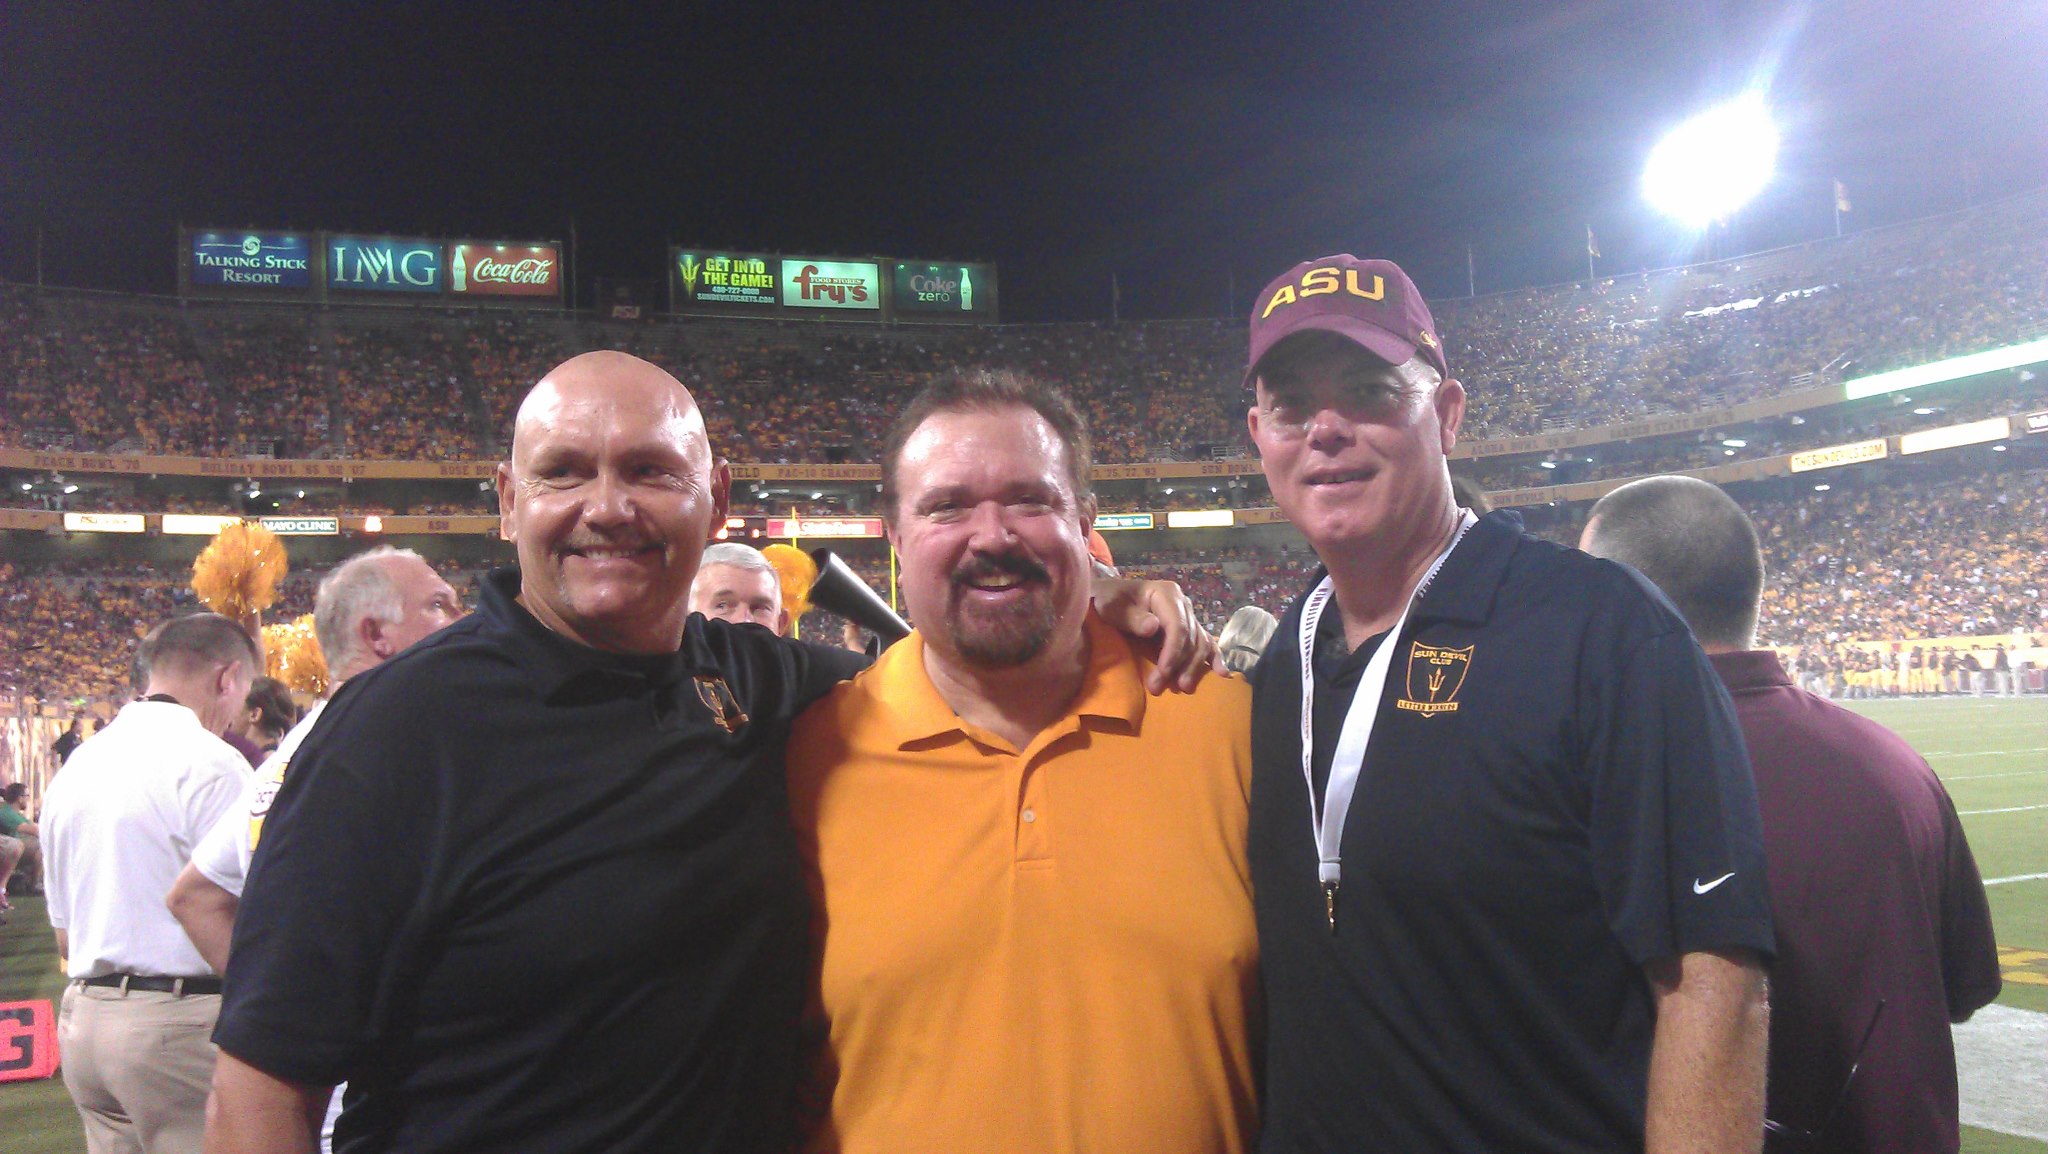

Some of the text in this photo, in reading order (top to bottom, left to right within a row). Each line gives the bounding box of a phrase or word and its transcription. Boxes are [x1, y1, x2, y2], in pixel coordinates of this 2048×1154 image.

[195, 252, 308, 270] TALKING STICK
[333, 246, 436, 286] IMG
[705, 257, 766, 275] GET INTO
[223, 269, 281, 284] RESORT
[473, 257, 554, 285] Coca-Cola
[702, 271, 774, 290] THE GAME!
[792, 264, 869, 305] fry's
[810, 278, 863, 286] FOOD STORES
[910, 274, 957, 293] Coke
[918, 291, 952, 303] zero
[1261, 266, 1385, 318] ASU
[200, 462, 255, 474] HOLIDAY
[262, 463, 296, 475] BOWL
[440, 464, 471, 476] ROSE
[1201, 461, 1257, 475] SUN BOWL
[1493, 493, 1512, 505] SUN
[262, 519, 336, 532] MAYO CLINIC
[1305, 587, 1329, 631] LETTERMEN
[1413, 650, 1468, 662] SUN DEVIL
[1429, 658, 1453, 666] CLUB
